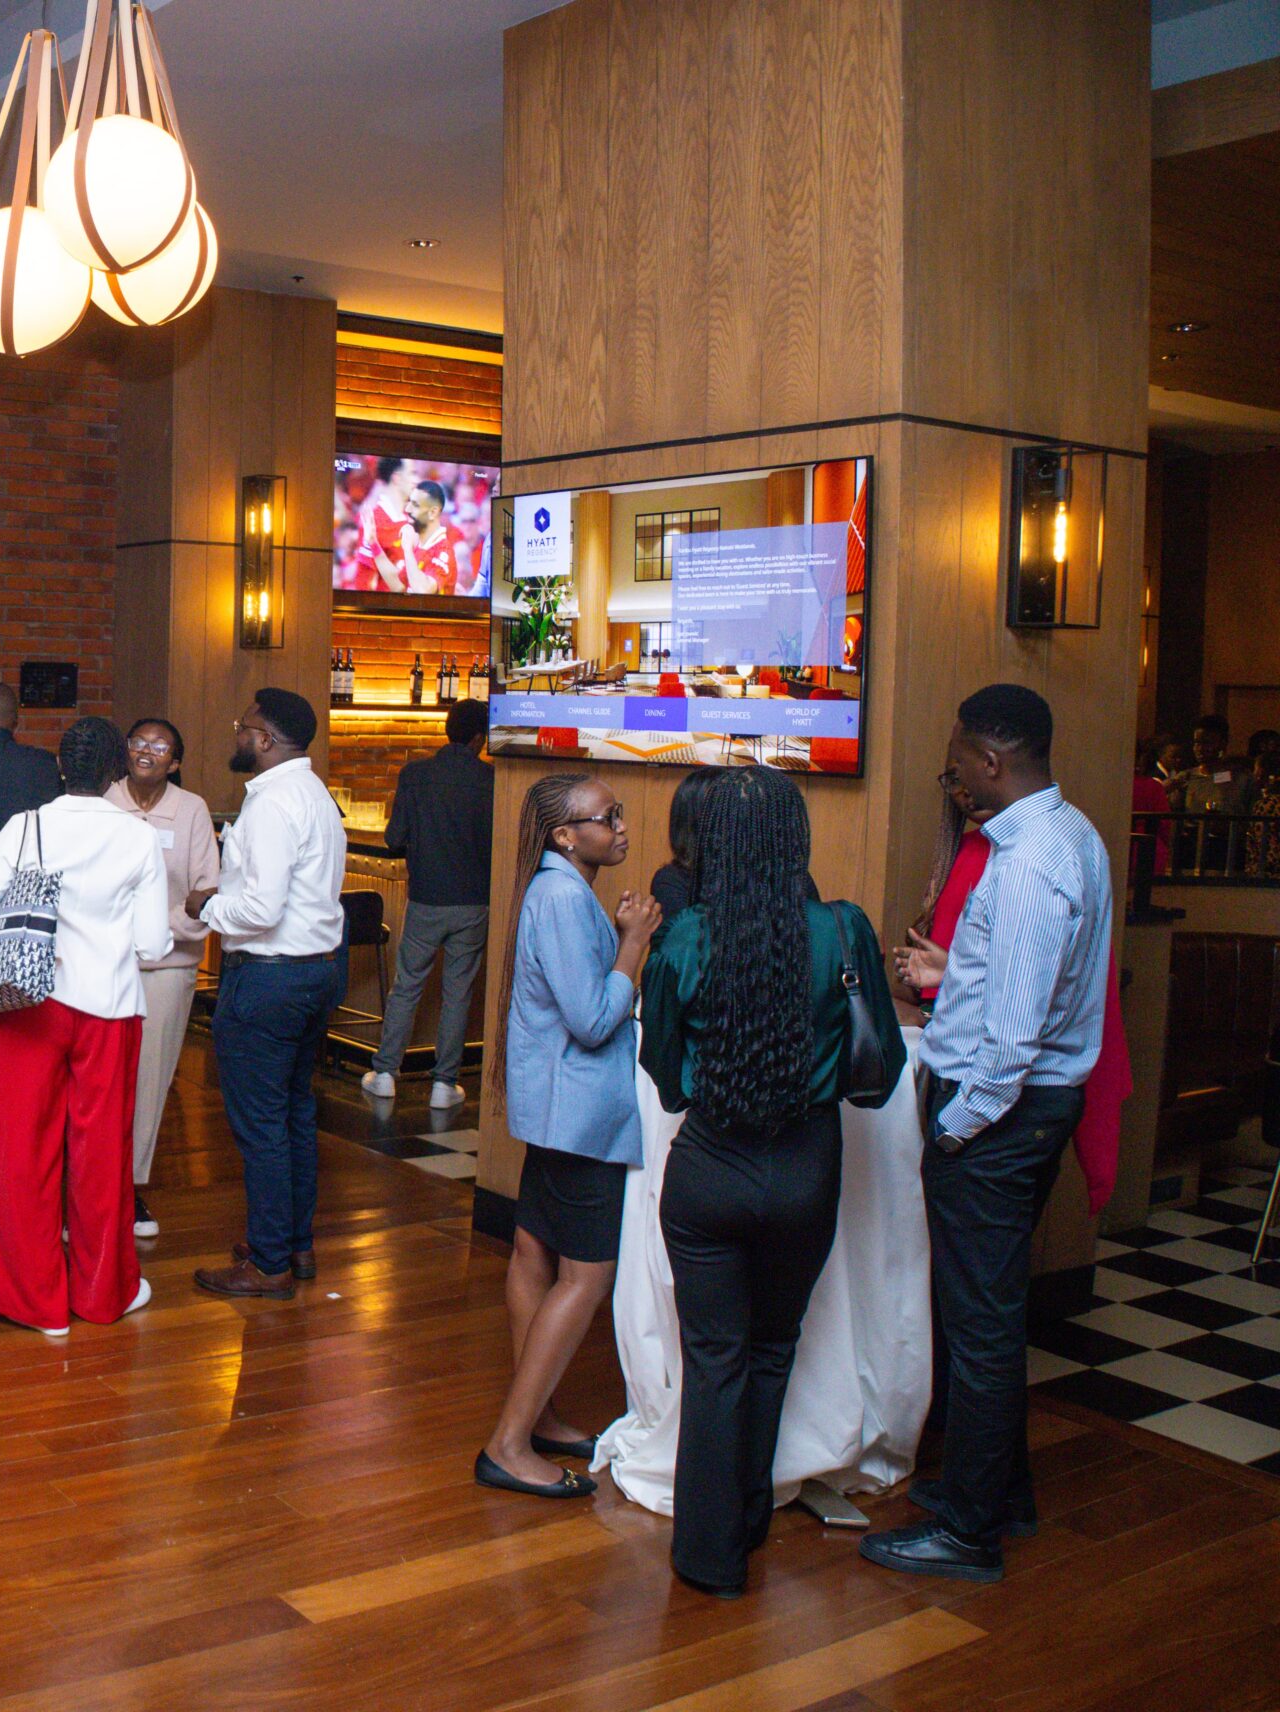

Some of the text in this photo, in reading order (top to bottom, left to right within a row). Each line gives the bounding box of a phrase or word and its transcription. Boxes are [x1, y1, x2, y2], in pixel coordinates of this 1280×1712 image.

[527, 536, 557, 548] HYATT
[527, 548, 558, 556] REGENCY
[520, 701, 536, 709] HOTEL
[511, 710, 545, 718] INFORMATION
[568, 707, 611, 716] CHANNEL GUIDE
[644, 708, 666, 718] DINING
[701, 710, 751, 720] GUEST SERVICES
[785, 707, 821, 717] WORLD OF
[792, 718, 812, 727] HYATT
